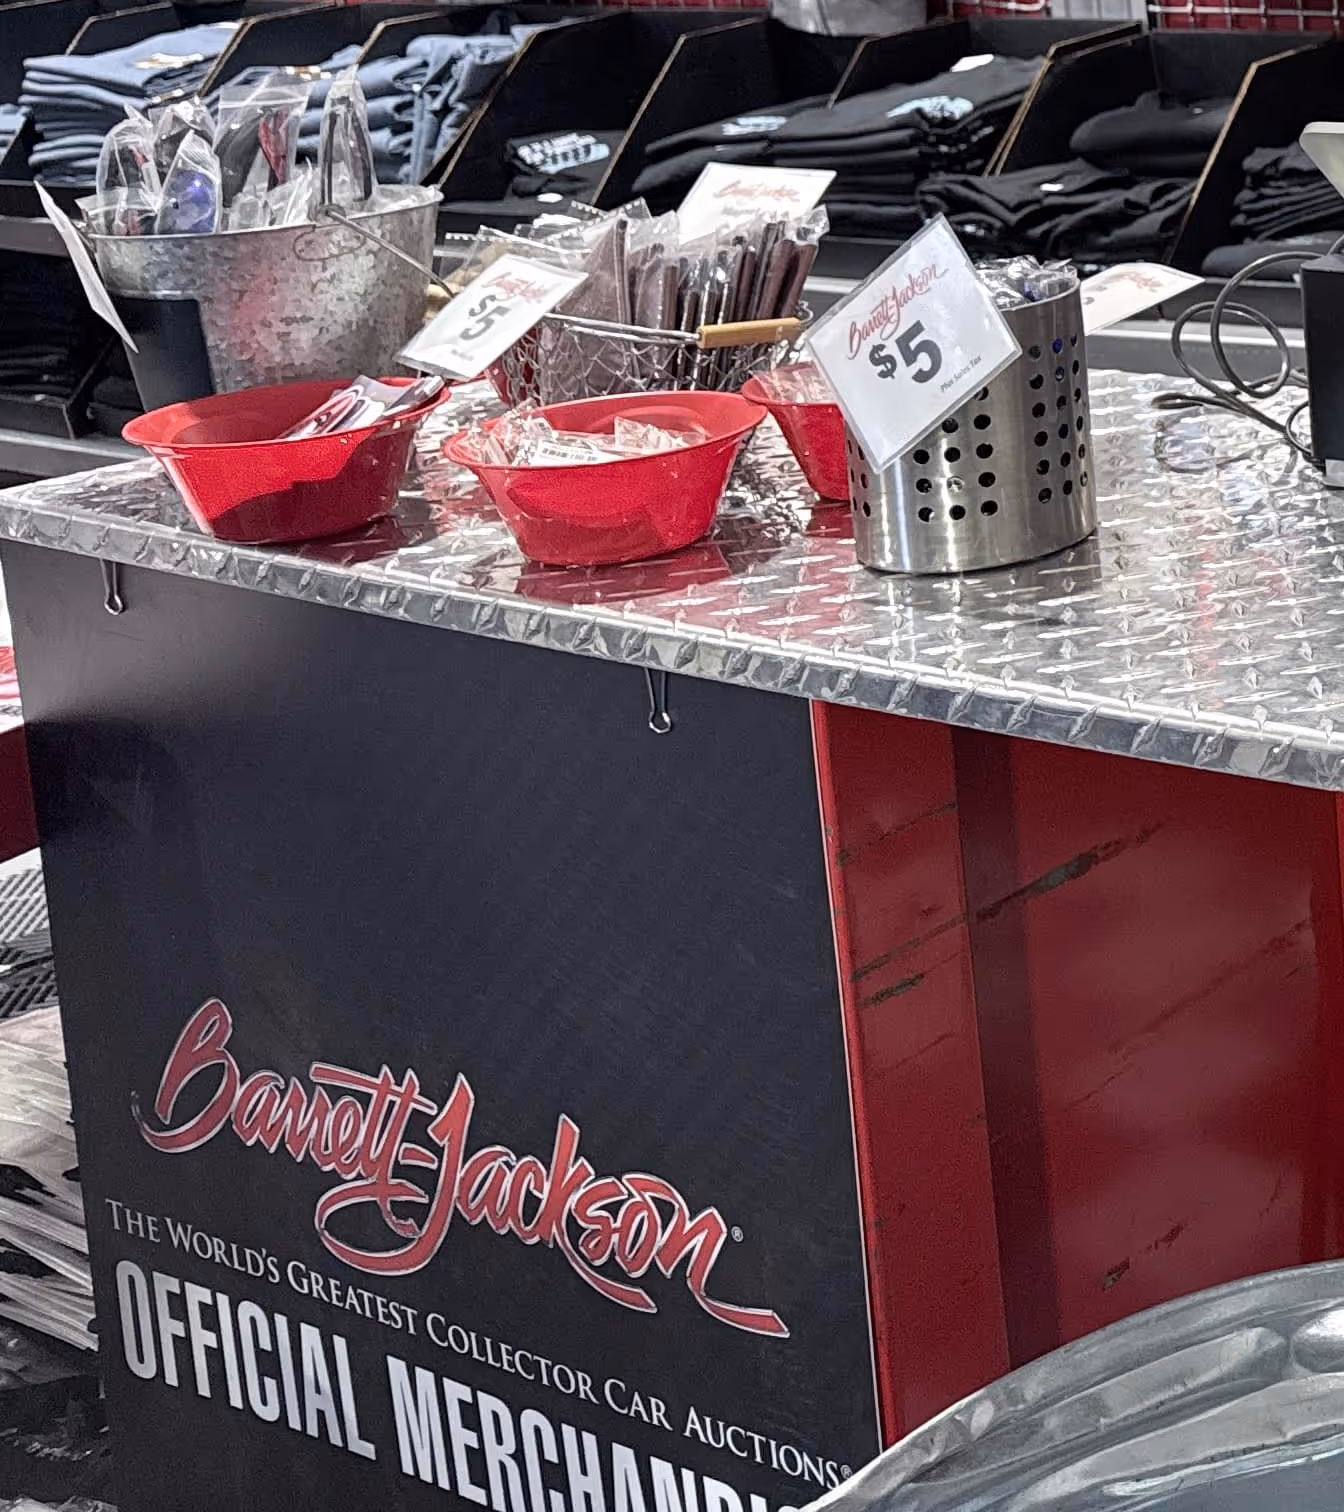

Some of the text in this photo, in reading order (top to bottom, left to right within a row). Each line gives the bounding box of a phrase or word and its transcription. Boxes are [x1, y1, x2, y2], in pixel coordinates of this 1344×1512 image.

[459, 293, 512, 343] $5
[848, 263, 950, 360] Barrett-Jackson
[868, 319, 943, 385] $5
[969, 355, 983, 372] Tax
[131, 996, 790, 1338] Barrett-Jackson
[105, 1196, 841, 1490] THE WORLD'S GREATEST COLLECTOR CAR AUCTIONS
[115, 1258, 376, 1462] OFFICIAL
